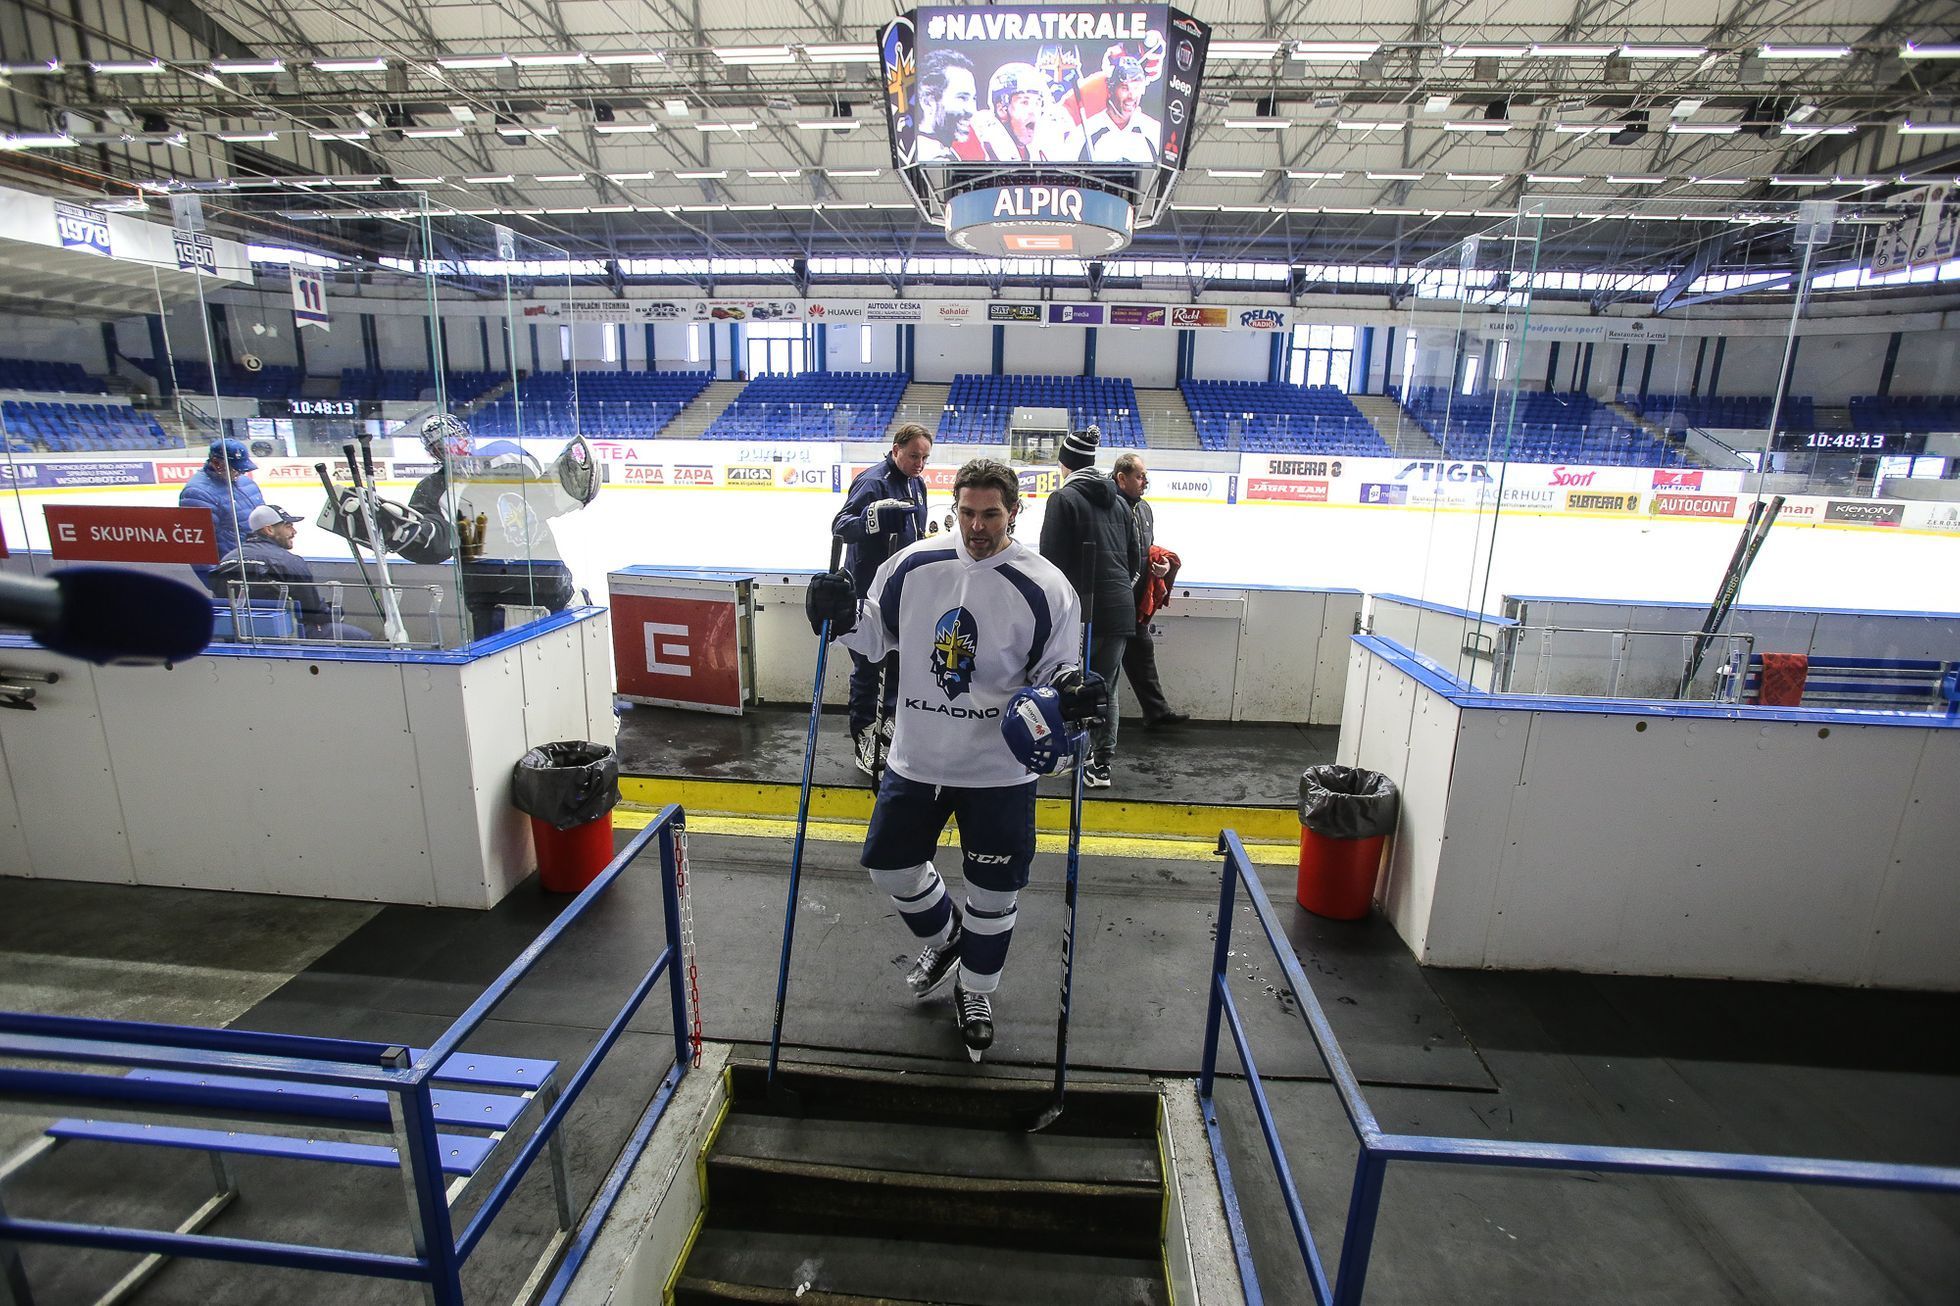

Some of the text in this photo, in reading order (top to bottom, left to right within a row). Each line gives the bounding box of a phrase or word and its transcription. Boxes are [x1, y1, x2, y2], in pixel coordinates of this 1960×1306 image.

[928, 12, 1148, 40] #NAVRATKRALE
[1169, 75, 1192, 97] Jeep
[993, 187, 1083, 222] ALPIQ
[58, 217, 110, 247] 1978
[299, 279, 321, 310] 11
[602, 302, 630, 310] TECHNIKA
[1240, 309, 1285, 327] RELAX
[1608, 330, 1645, 338] Restaurace
[291, 401, 355, 416] 10:48:13
[1806, 434, 1885, 448] 10:48:13
[625, 468, 664, 479] ZAPA
[674, 469, 714, 480] ZAPA
[728, 468, 772, 480] STIGA
[1269, 460, 1328, 476] SUBTERRA
[1394, 462, 1494, 483] STIGA
[801, 470, 827, 483] IGT
[1171, 481, 1208, 492] KLADNO
[1289, 485, 1327, 494] TEAM
[1568, 494, 1625, 510] SUBTERRA
[1659, 498, 1730, 513] AUTOCONT
[1835, 504, 1895, 516] Klenoty
[90, 526, 168, 543] SKUPINA
[172, 523, 205, 544] ČEZ
[905, 697, 1000, 720] KLADNO
[1023, 704, 1039, 724] HUAWEI
[967, 851, 1012, 865] CCM
